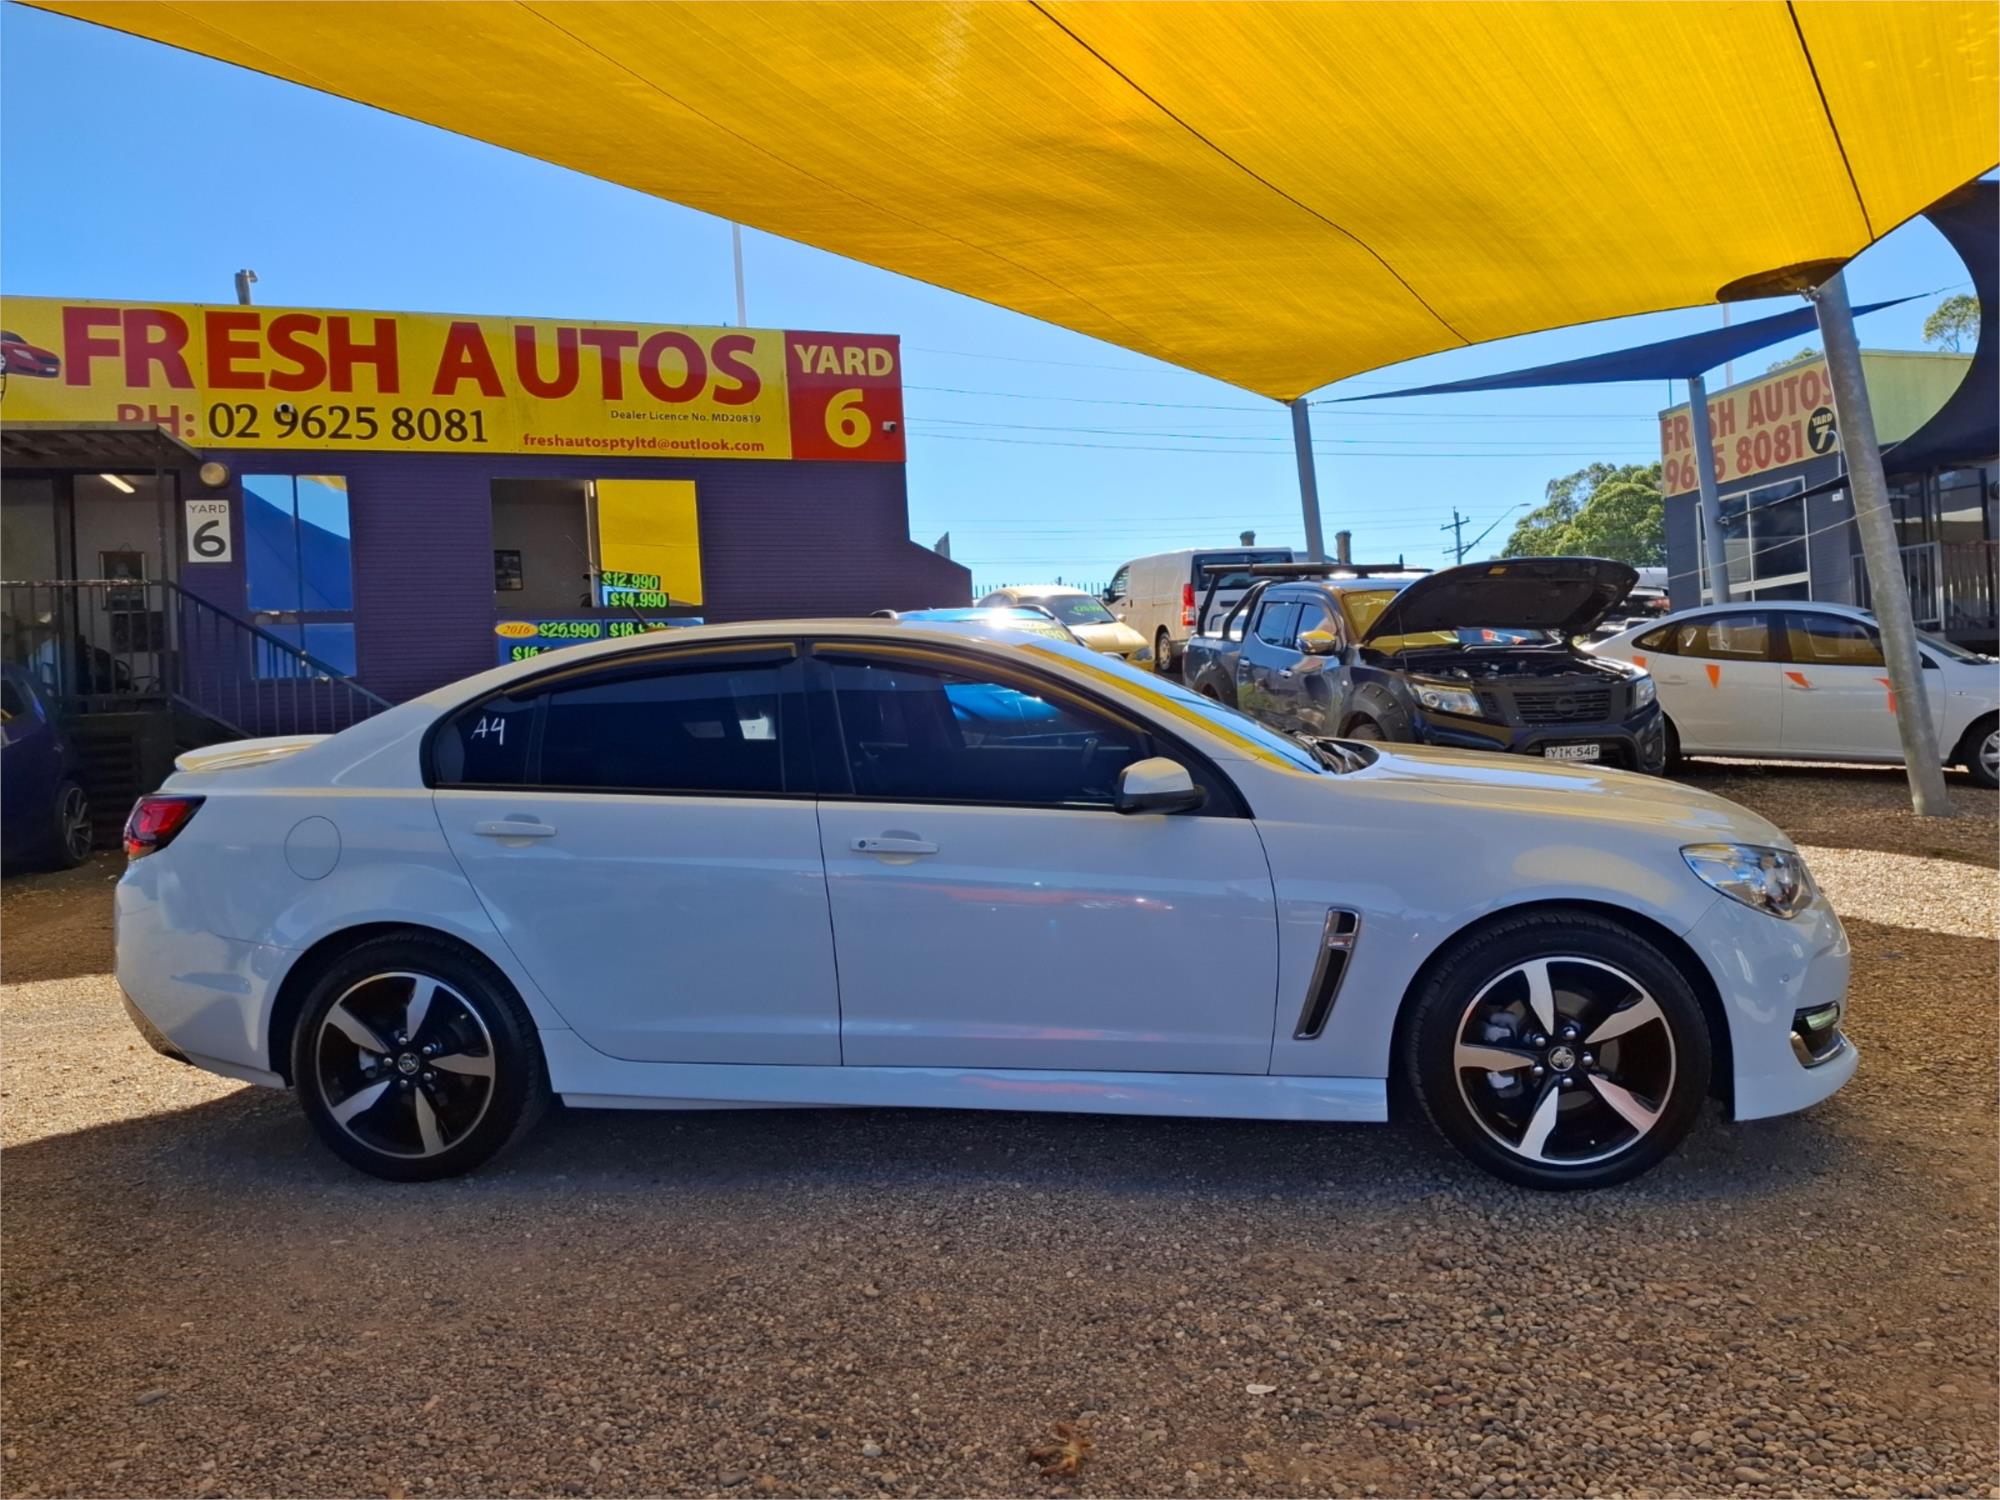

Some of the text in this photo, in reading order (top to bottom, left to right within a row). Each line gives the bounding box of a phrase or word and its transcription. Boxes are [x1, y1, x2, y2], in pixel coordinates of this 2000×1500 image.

[62, 306, 762, 405] FRESH AUTOS
[793, 344, 893, 376] YARD
[117, 403, 488, 443] PH: 02 9625 8081
[611, 409, 761, 424] Dealer Licence No. MD20819
[825, 388, 871, 448] 6
[1662, 397, 1736, 455] FRSH
[1812, 412, 1834, 425] YARD
[523, 433, 764, 452] freshautosptyltd@outlook.com
[1815, 424, 1830, 450] 7
[1664, 419, 1805, 494] 965 8081
[188, 504, 227, 514] YARD
[193, 520, 226, 557] 6
[602, 572, 658, 590] $12.990
[610, 592, 667, 608] $14.990
[503, 625, 531, 635] 2016
[538, 622, 600, 639] $25.990
[470, 716, 505, 746] A4
